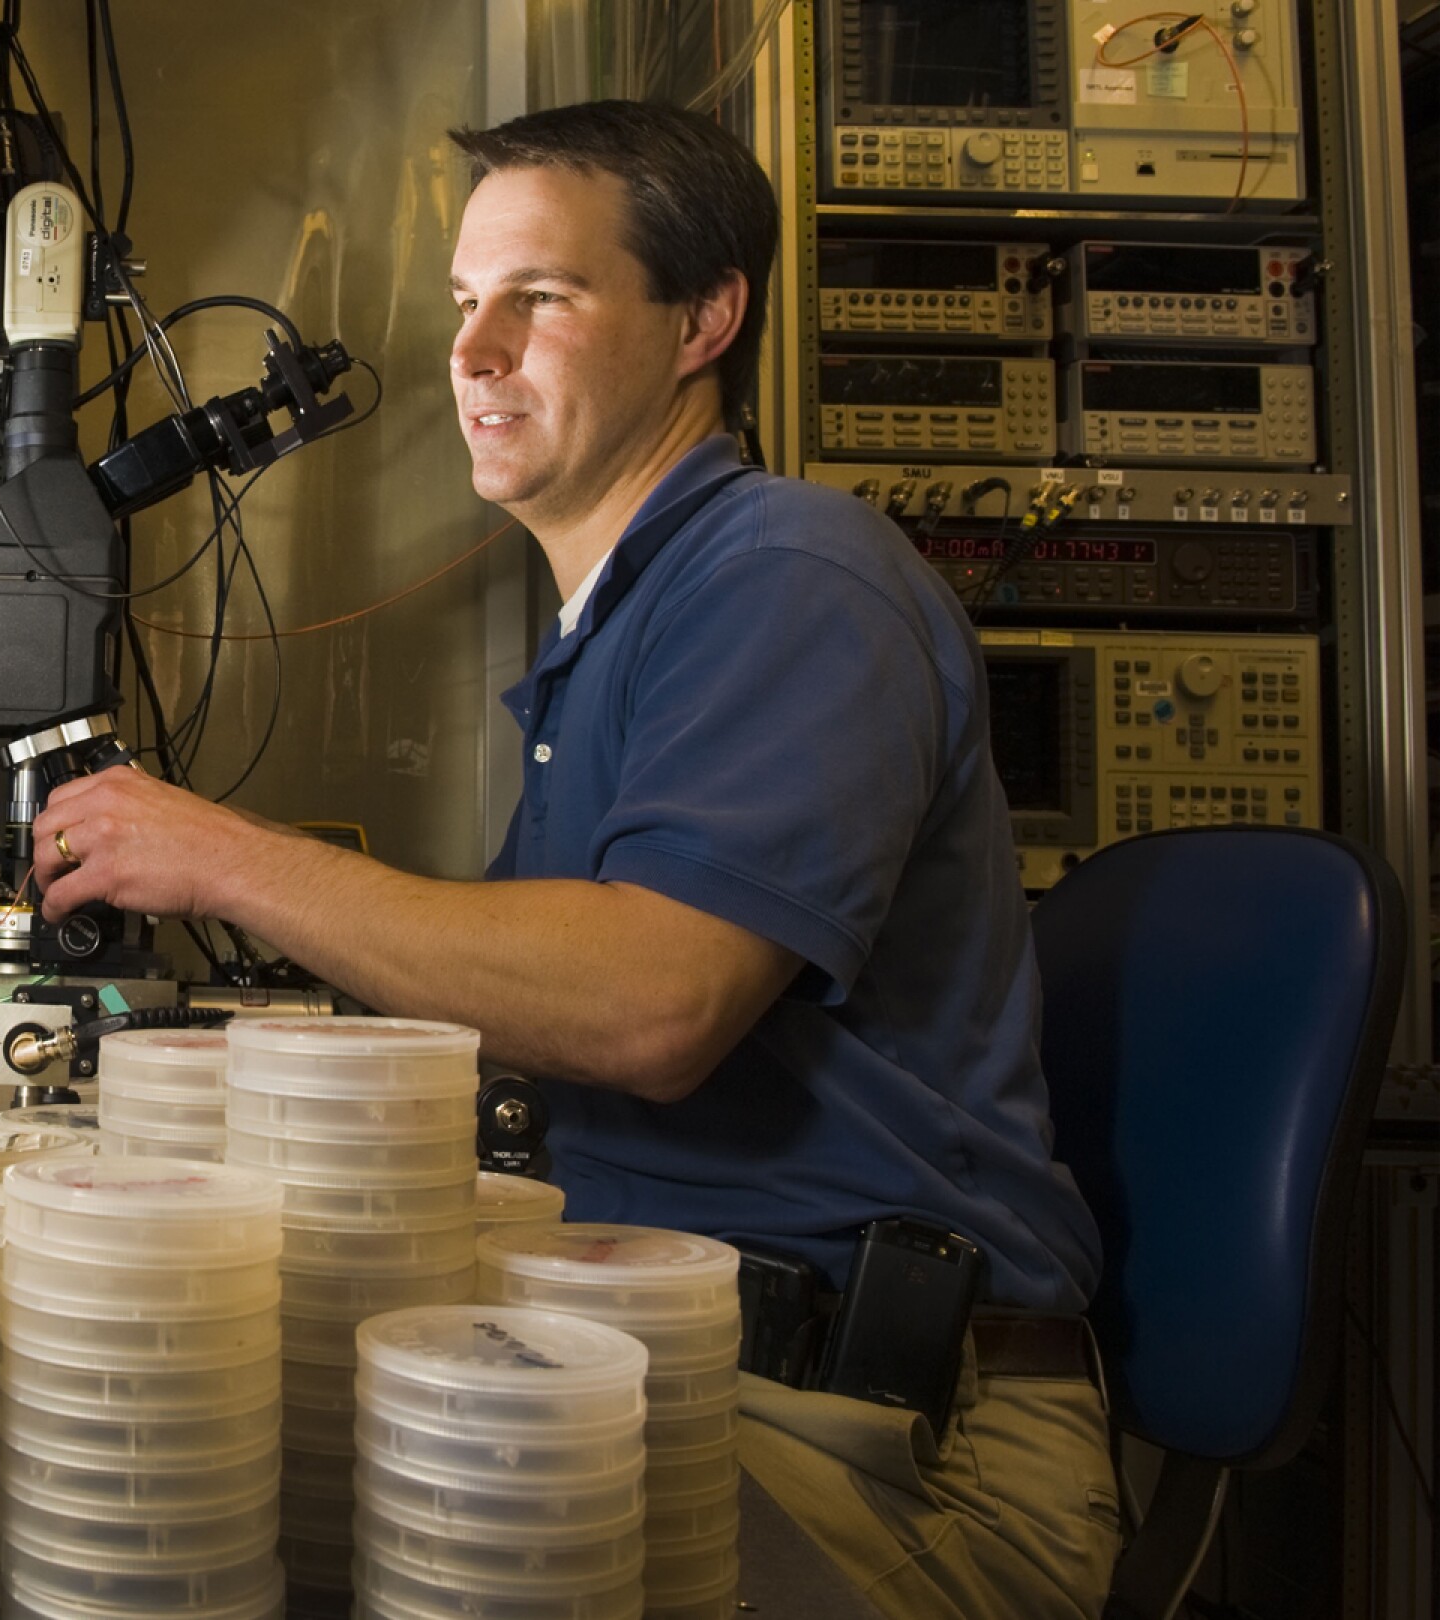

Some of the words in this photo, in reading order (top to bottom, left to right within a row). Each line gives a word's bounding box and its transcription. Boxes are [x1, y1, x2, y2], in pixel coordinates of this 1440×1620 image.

[28, 200, 37, 238] Panasonic
[40, 196, 55, 242] digital
[902, 467, 931, 479] SMU
[1101, 473, 1120, 482] VSU
